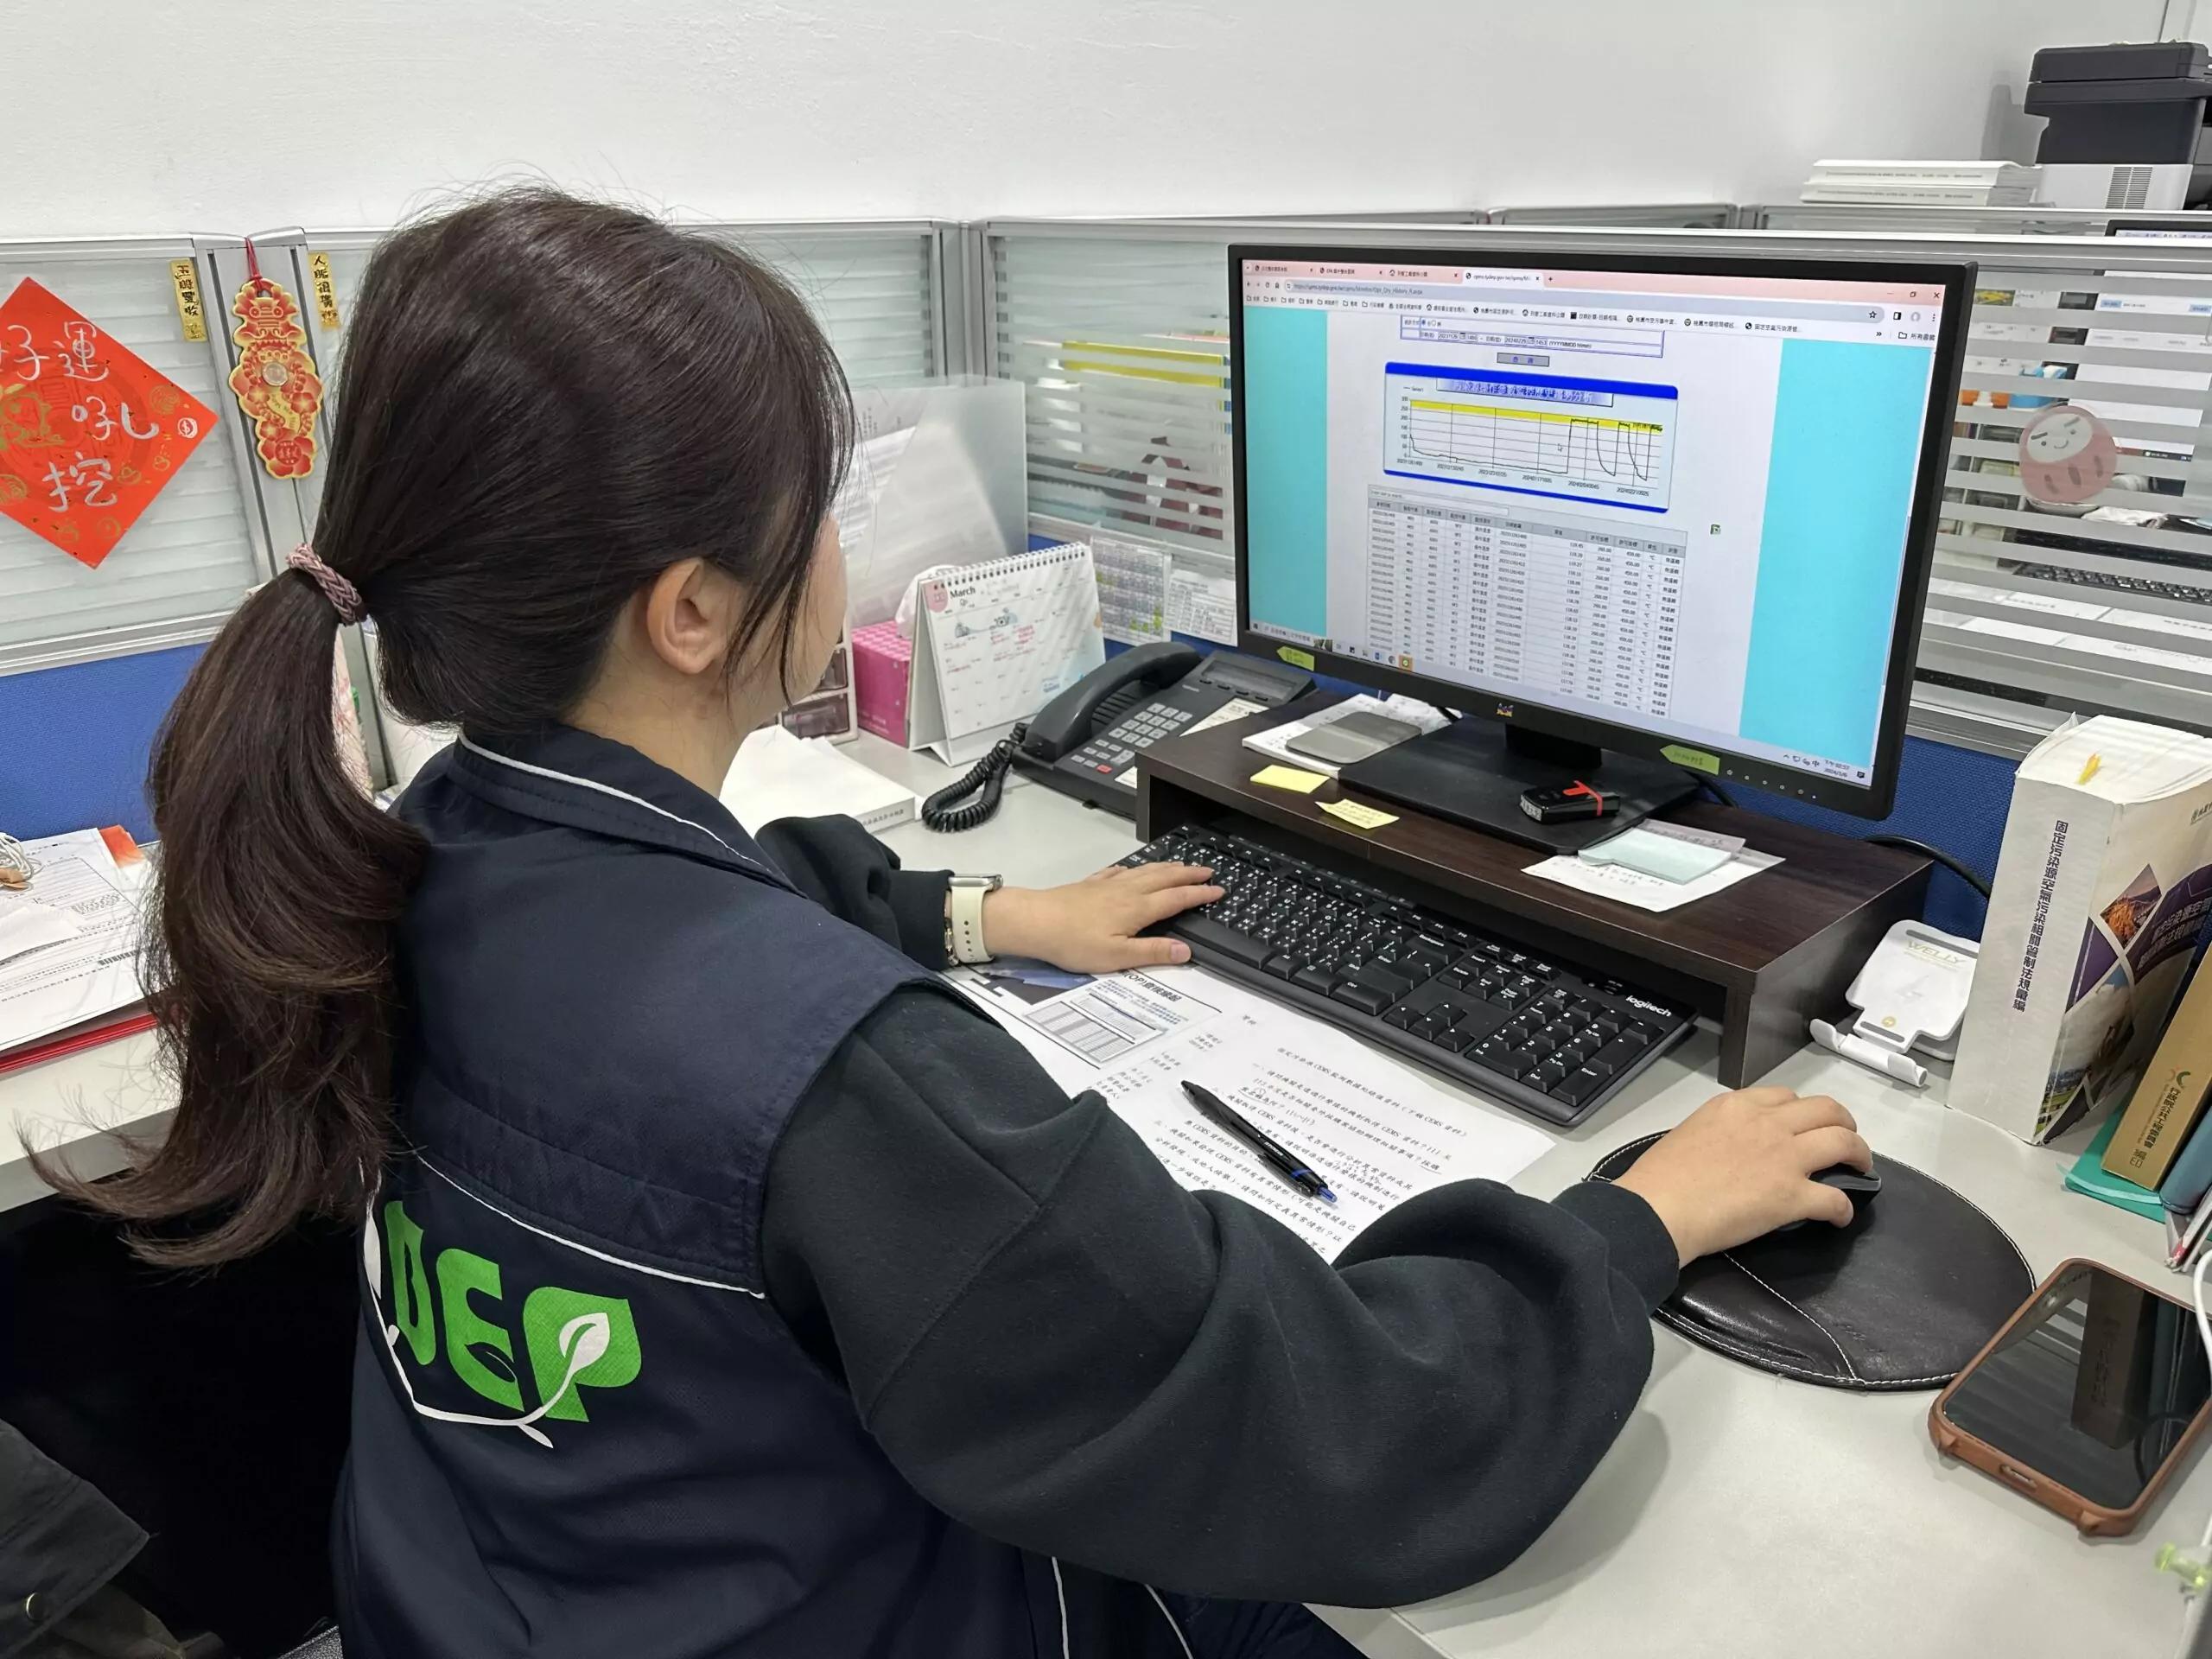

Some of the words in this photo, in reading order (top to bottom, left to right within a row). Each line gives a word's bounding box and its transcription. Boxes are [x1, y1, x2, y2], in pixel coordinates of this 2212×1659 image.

[950, 586, 976, 599] March
[1908, 940, 1967, 964] WELLY
[1625, 995, 1672, 1017] logitech
[1581, 1067, 1597, 1077] Enter
[1214, 1152, 1234, 1165] CEMS
